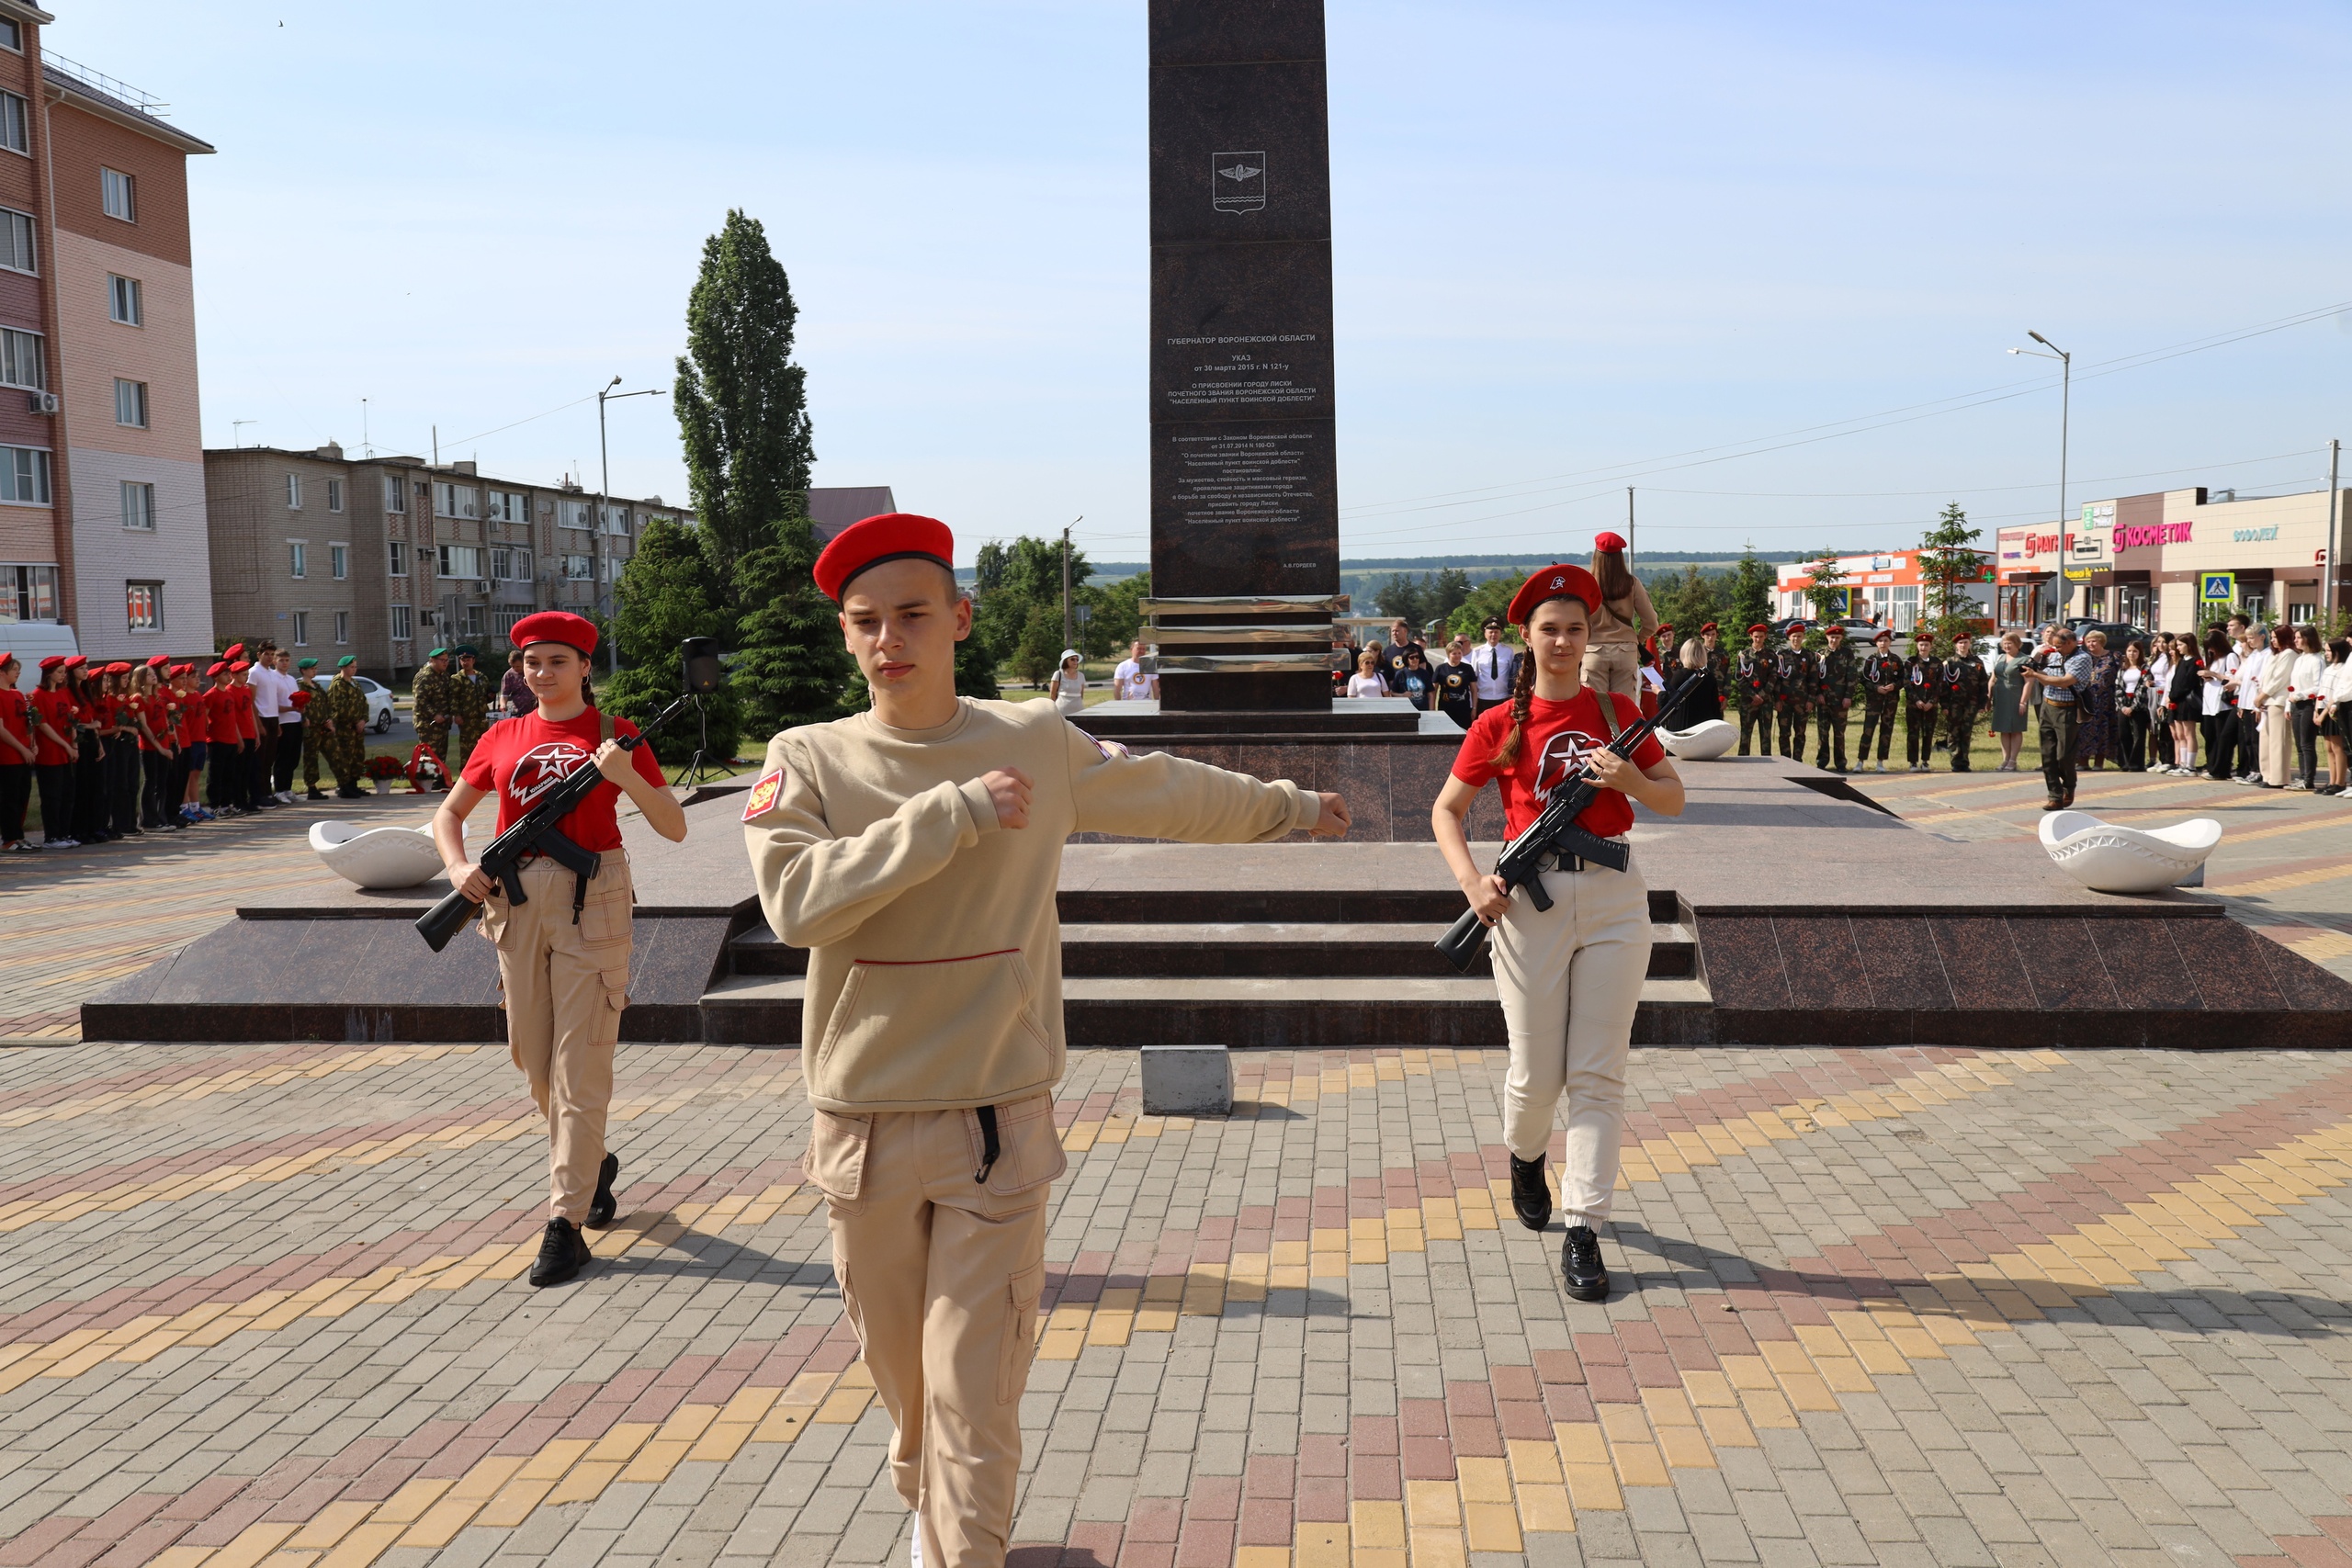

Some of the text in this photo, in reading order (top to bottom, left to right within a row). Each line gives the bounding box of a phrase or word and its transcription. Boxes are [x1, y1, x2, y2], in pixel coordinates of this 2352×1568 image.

[1167, 336, 1216, 344] ГУБЕРНАТОР
[1217, 334, 1277, 344] ВОРОНЕЖСКОЙ
[2126, 522, 2192, 547] КОСМЕТИК
[529, 775, 554, 794] ЮНАРМИЯ
